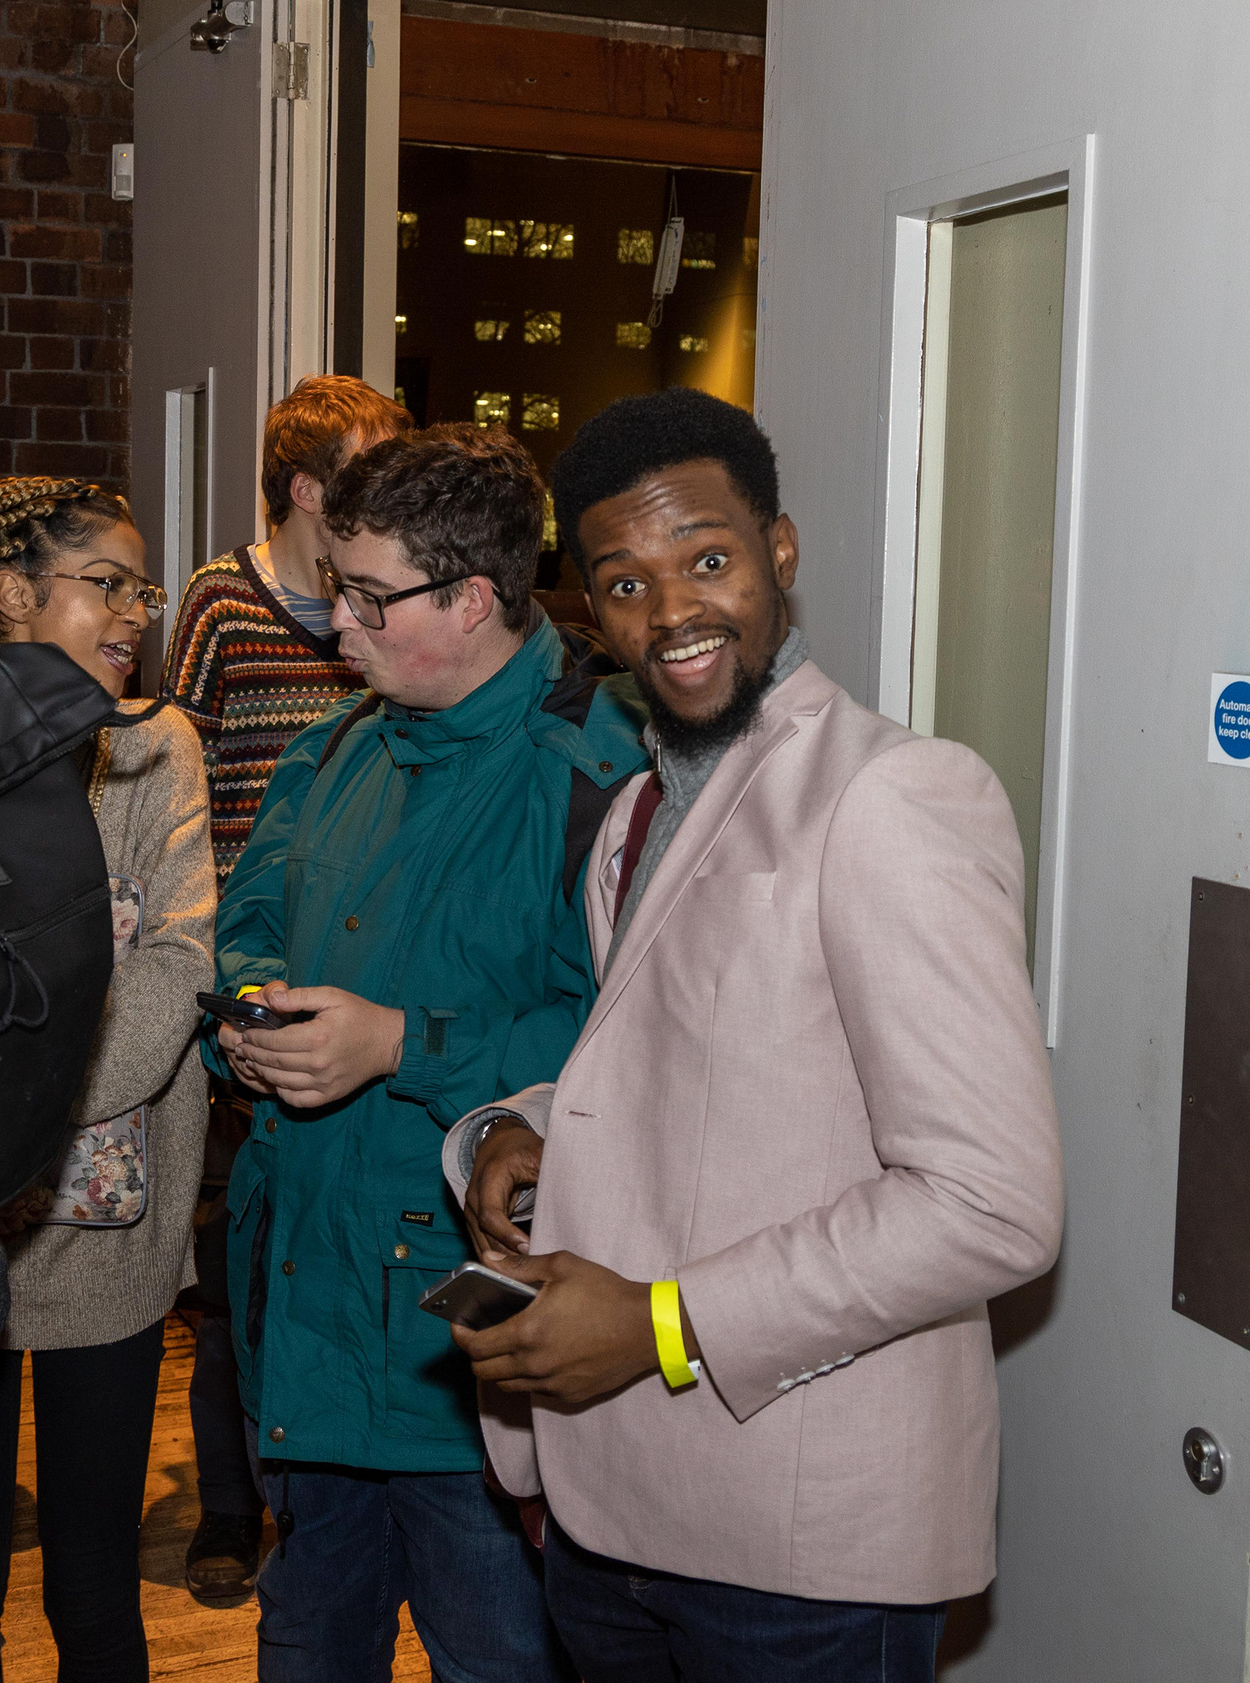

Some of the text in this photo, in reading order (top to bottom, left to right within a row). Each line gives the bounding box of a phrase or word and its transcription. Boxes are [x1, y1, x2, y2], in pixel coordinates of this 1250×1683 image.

[1222, 713, 1250, 726] fire do
[1219, 725, 1239, 740] keep
